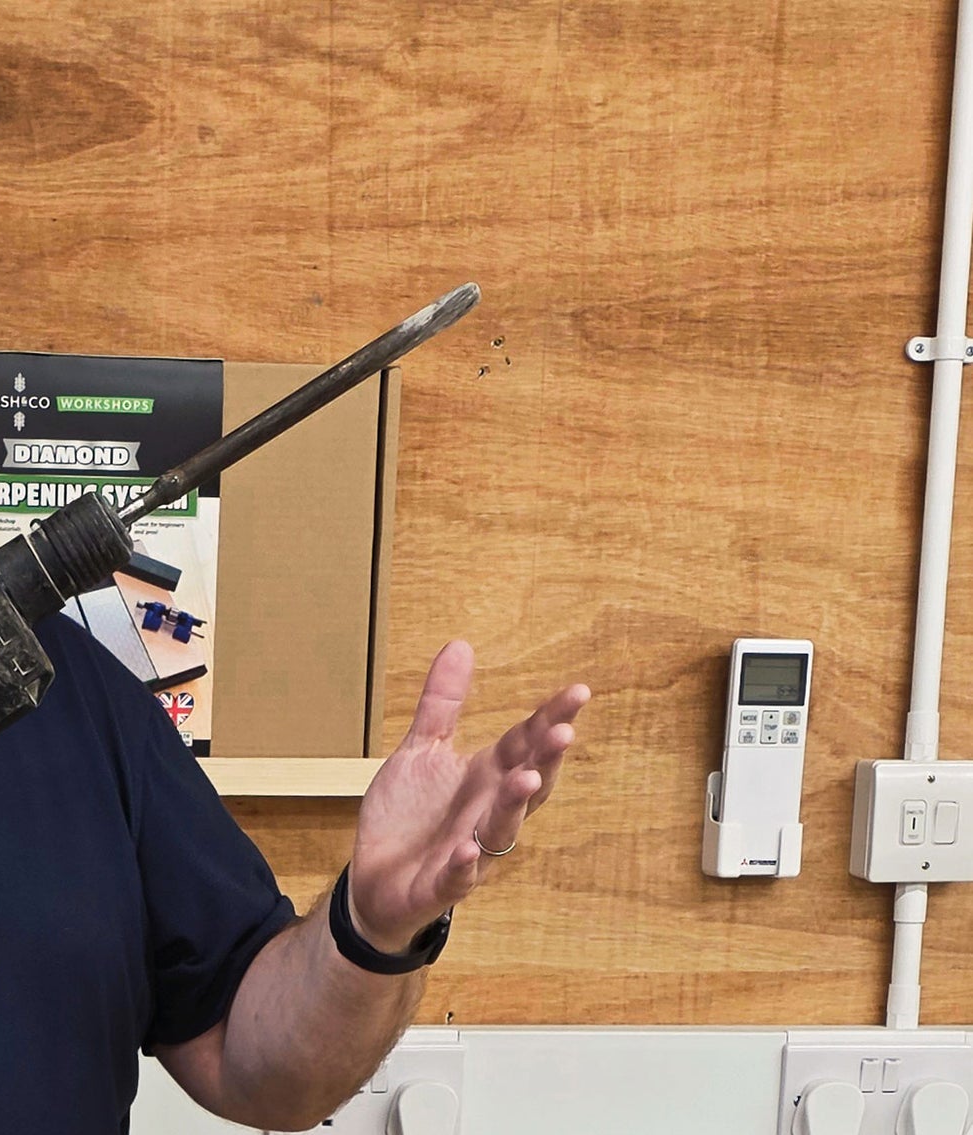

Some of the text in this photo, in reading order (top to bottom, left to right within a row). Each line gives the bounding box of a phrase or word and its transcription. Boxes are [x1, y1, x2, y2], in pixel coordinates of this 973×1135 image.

[61, 399, 149, 411] WORKSHOPS
[14, 445, 129, 465] DIAMOND
[102, 485, 187, 509] SYS
